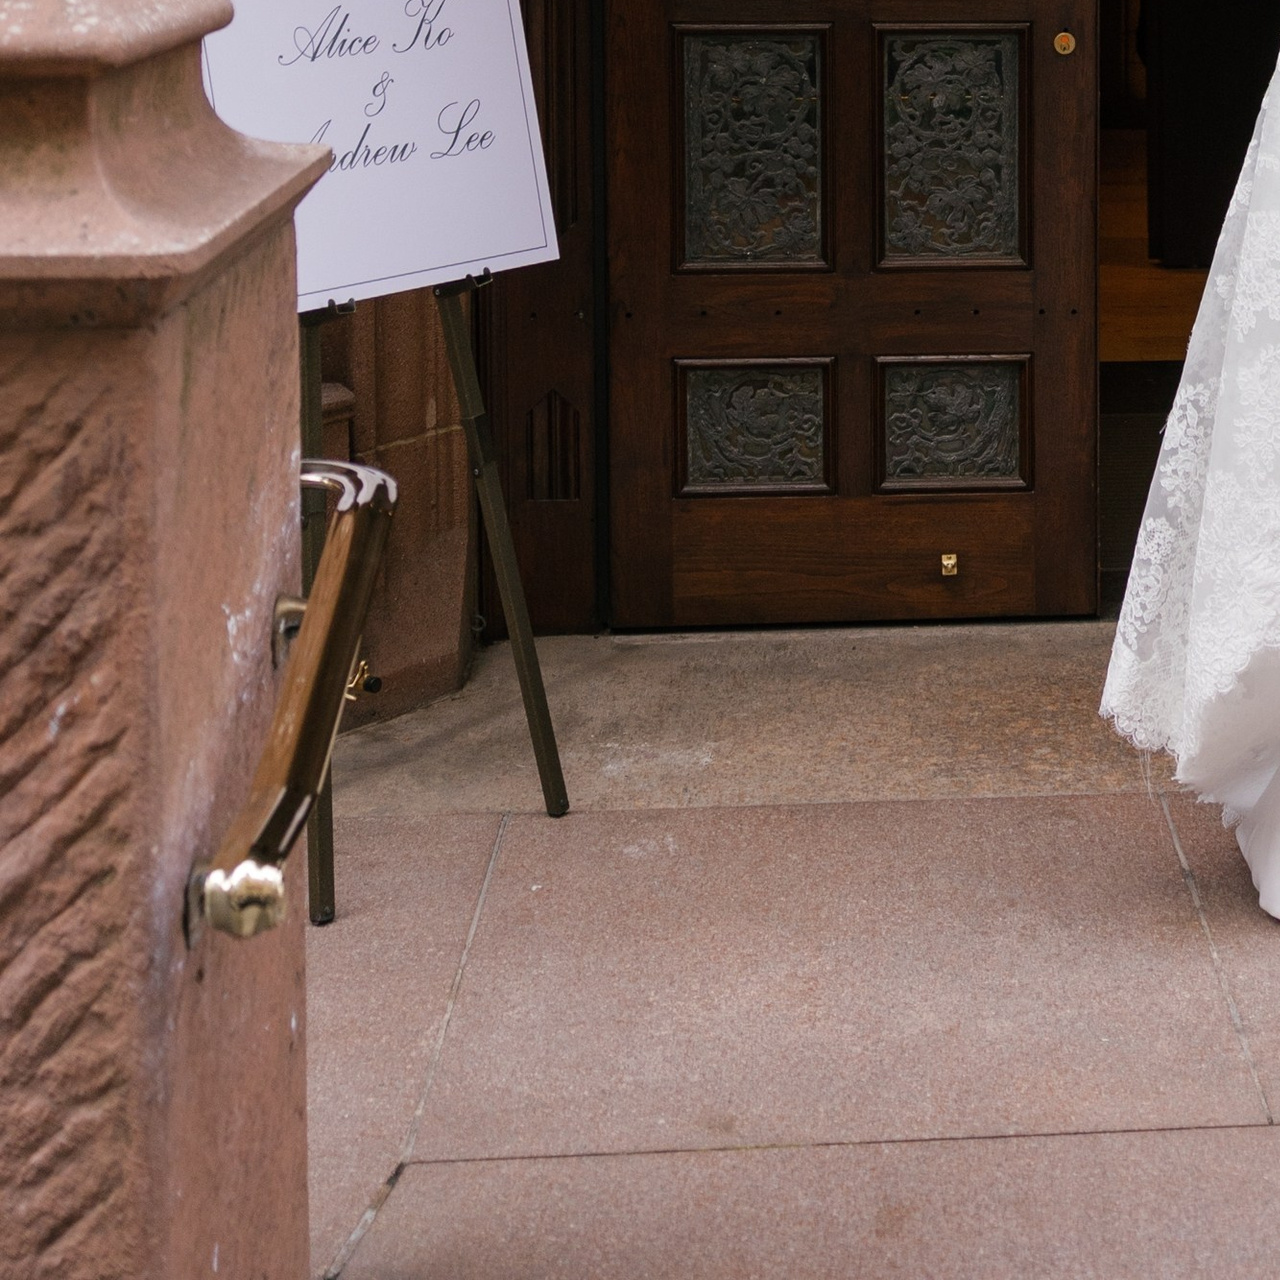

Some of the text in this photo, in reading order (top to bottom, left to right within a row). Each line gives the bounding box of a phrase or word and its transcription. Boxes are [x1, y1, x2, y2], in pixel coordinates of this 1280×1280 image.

[278, 4, 380, 66] Alice
[364, 71, 394, 117] &
[429, 98, 496, 159] Lee
